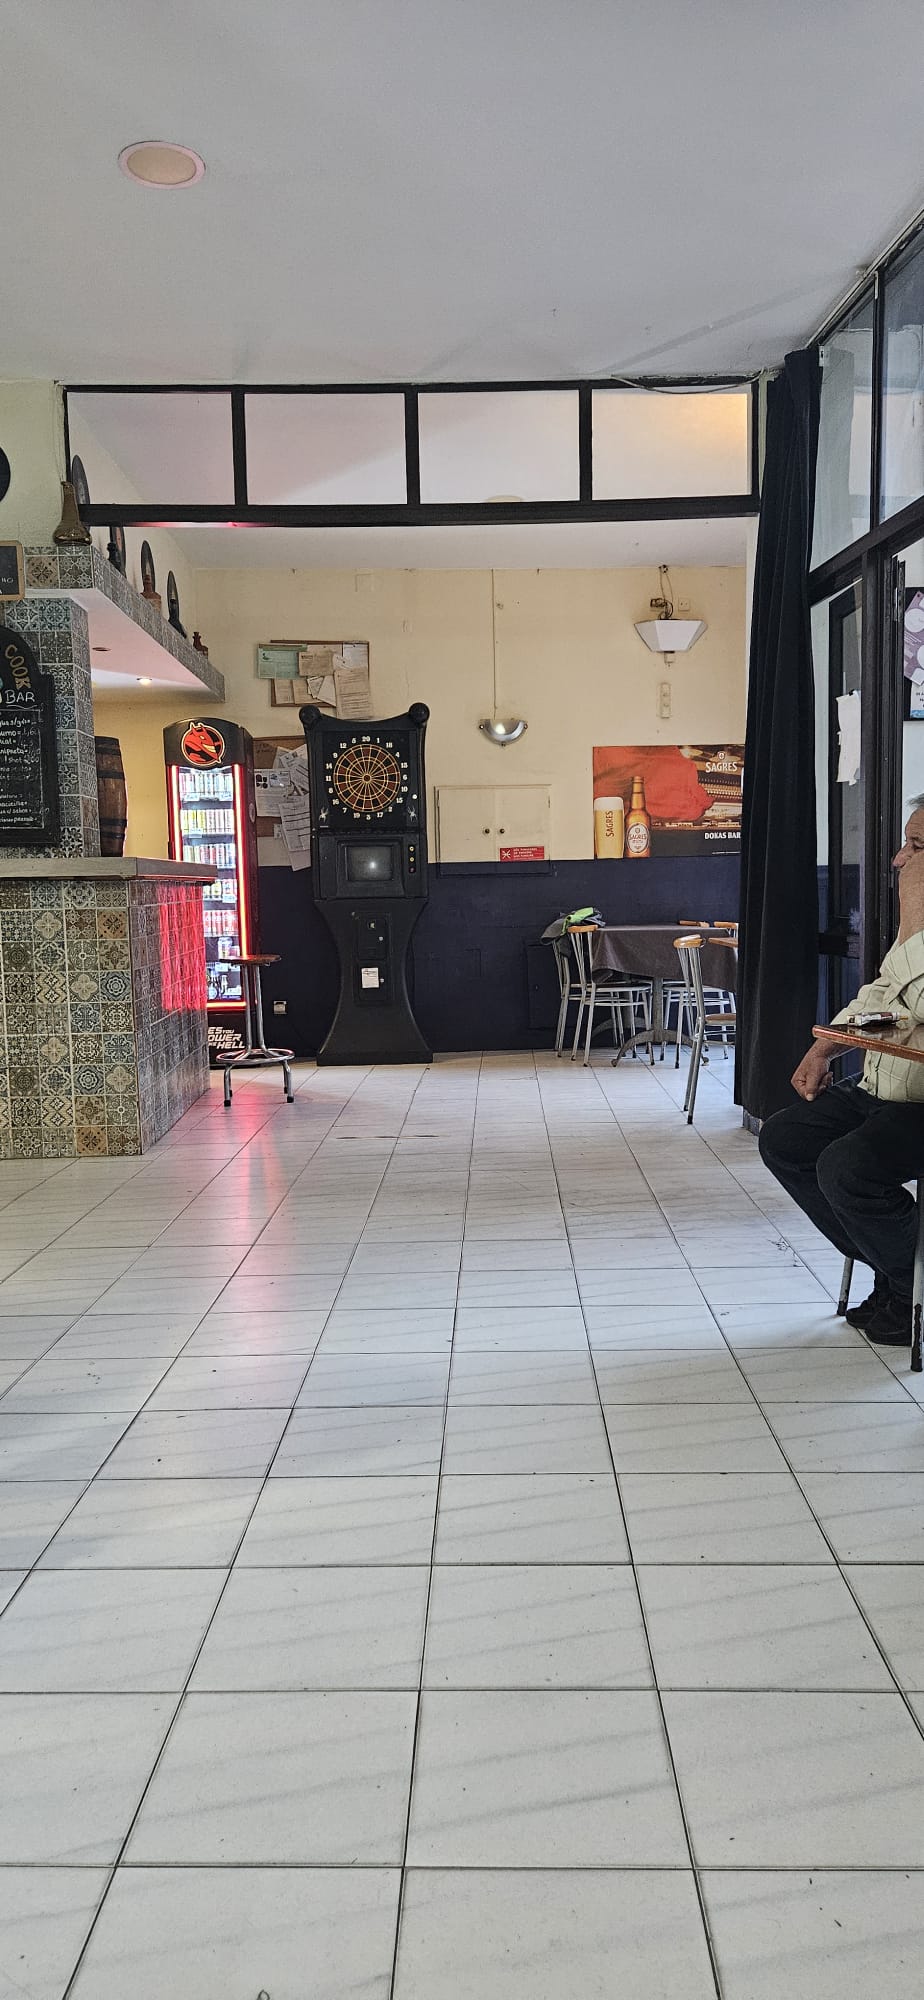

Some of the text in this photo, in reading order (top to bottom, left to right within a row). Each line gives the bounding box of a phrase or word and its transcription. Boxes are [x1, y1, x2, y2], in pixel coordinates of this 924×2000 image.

[5, 644, 31, 690] COOK
[5, 690, 35, 703] BAR
[705, 761, 738, 773] SAGRES
[604, 810, 614, 838] SAGRES
[704, 831, 741, 840] DOKAS BAR
[217, 1041, 245, 1049] HELL
